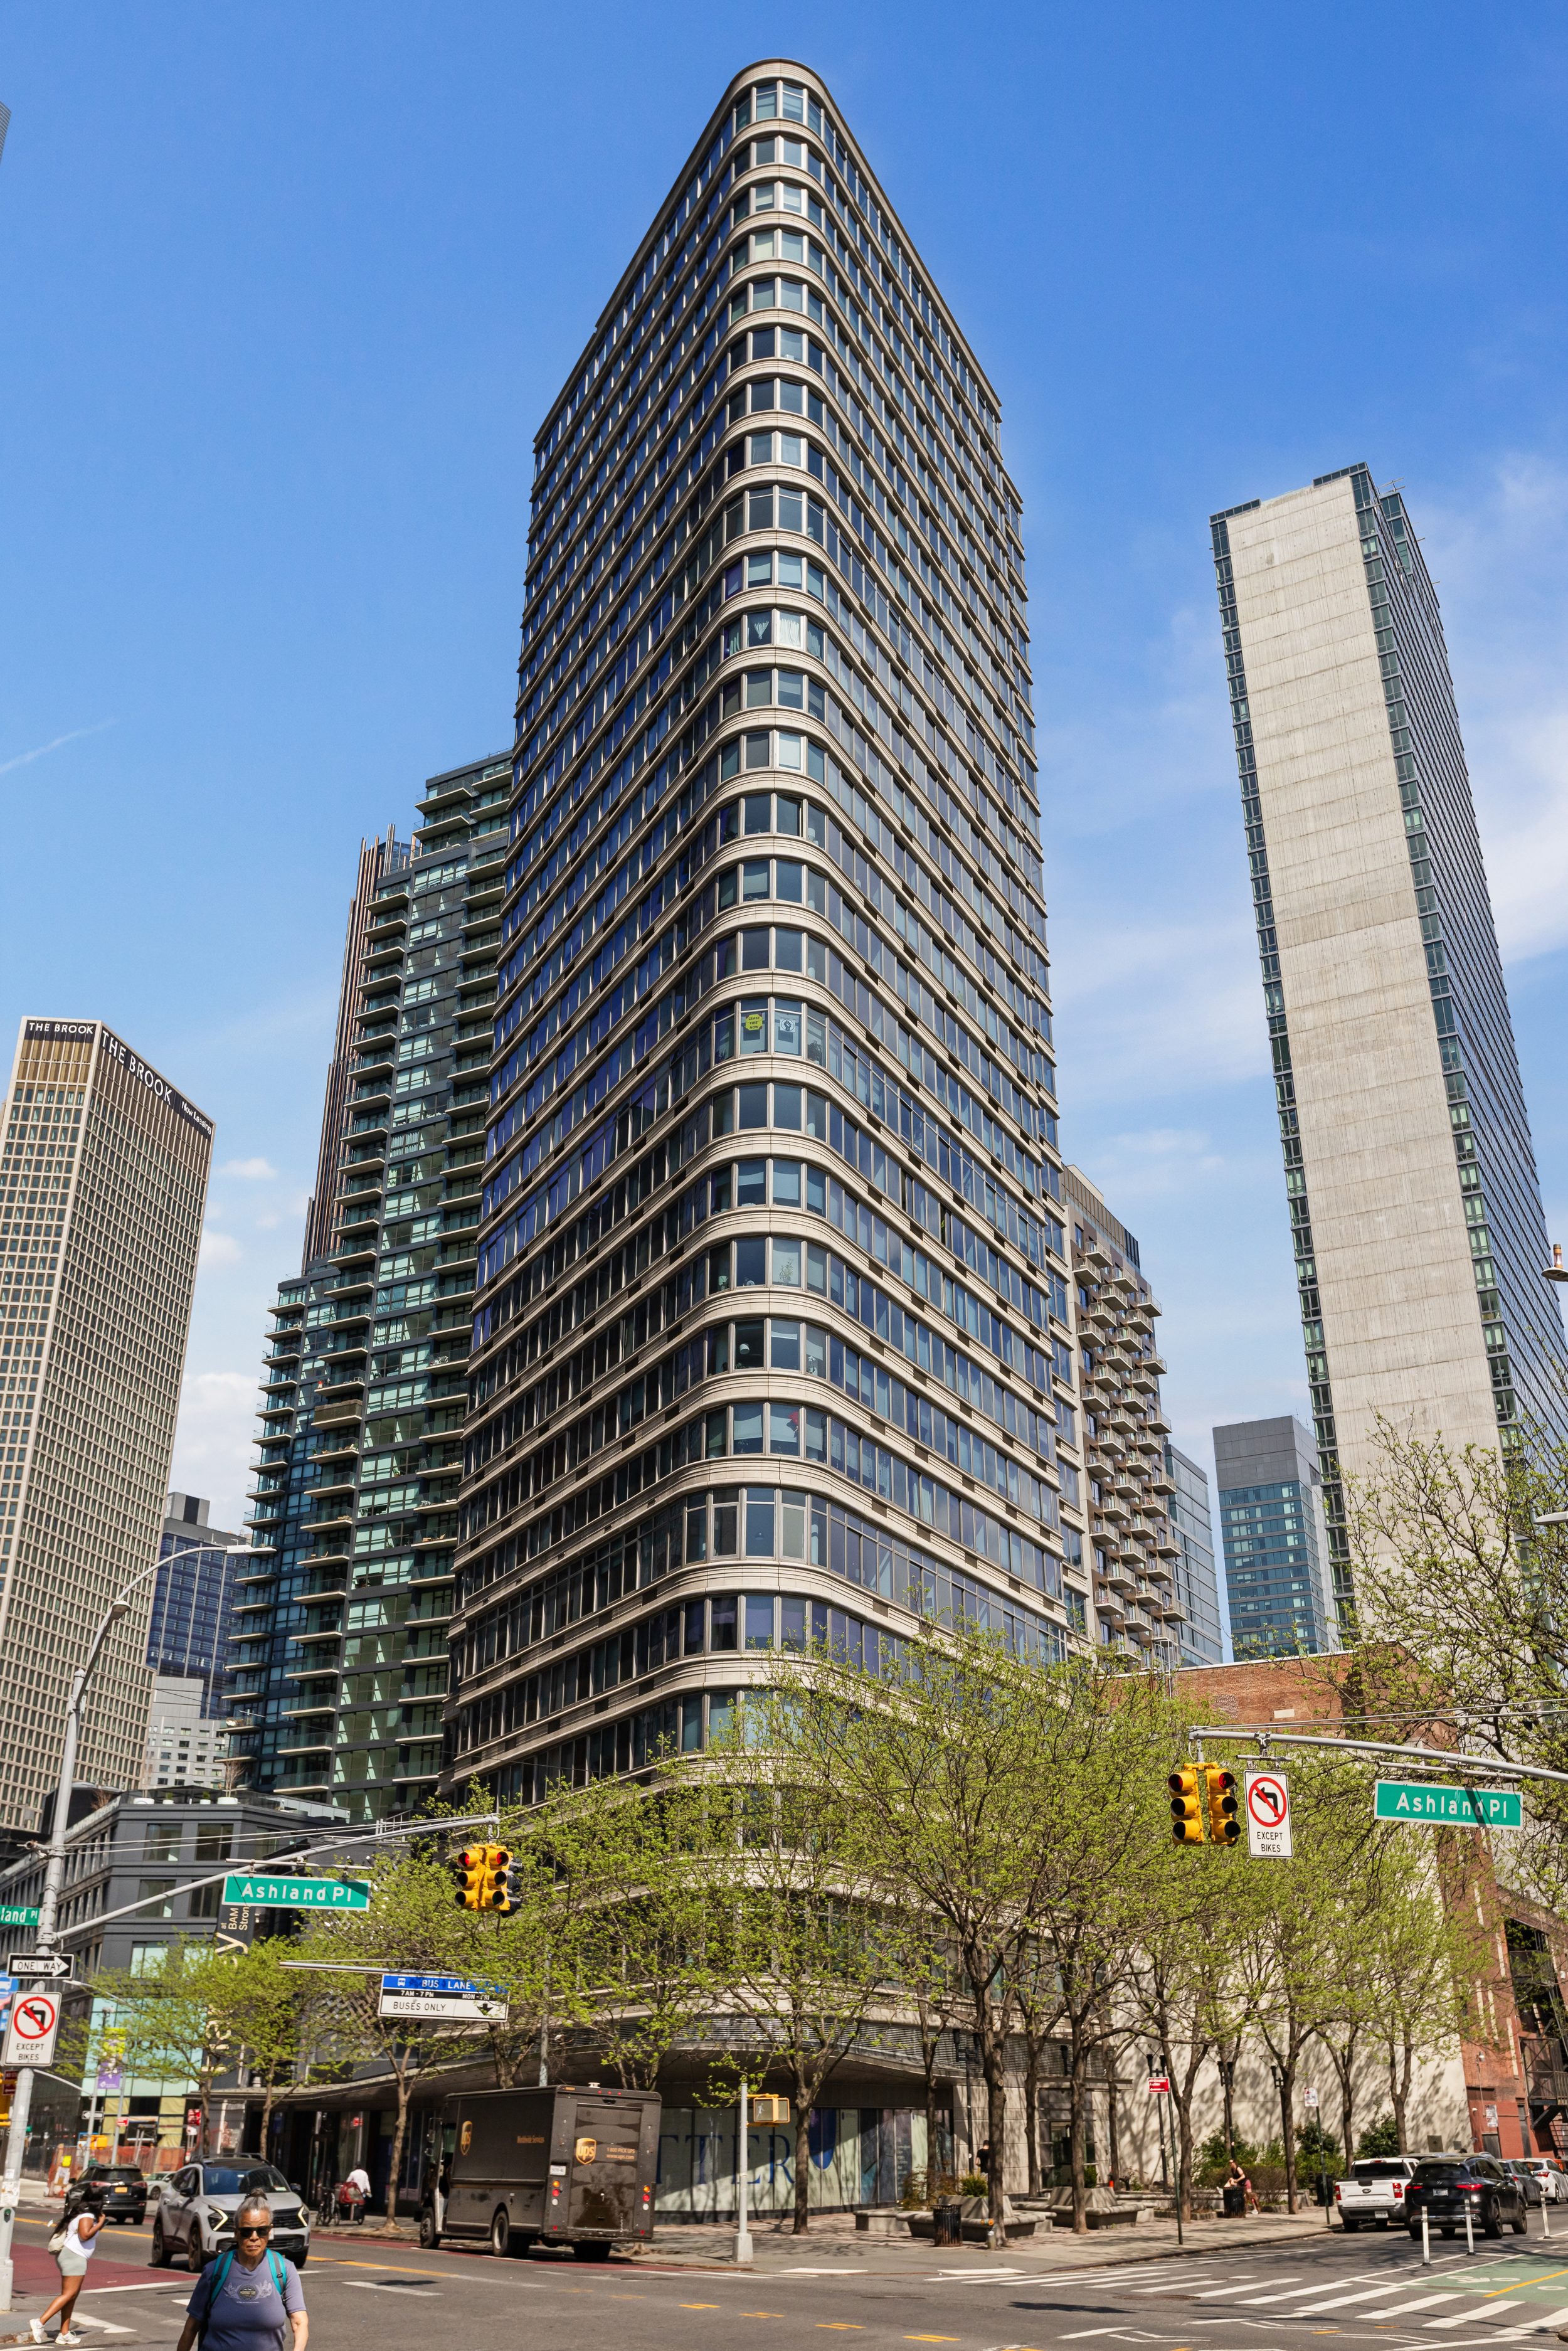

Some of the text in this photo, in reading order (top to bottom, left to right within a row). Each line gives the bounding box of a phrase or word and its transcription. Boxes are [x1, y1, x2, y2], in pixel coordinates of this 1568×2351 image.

[29, 1022, 94, 1034] THE BROOK
[102, 1029, 212, 1135] THE BROOK Now Leasing
[1396, 1791, 1507, 1818] Ashland Pl
[1257, 1832, 1283, 1840] EXCEPT
[1261, 1844, 1281, 1852] BIKES
[241, 1882, 352, 1902] Ashland Pl
[31, 1910, 38, 1919] Pl
[228, 1908, 238, 1930] BAM
[238, 1907, 250, 1931] Stron
[18, 1961, 62, 1971] ONE WAY
[421, 1979, 471, 1990] BUS LANE
[393, 2002, 447, 2012] BUSES ONLY
[578, 2146, 595, 2160] ups
